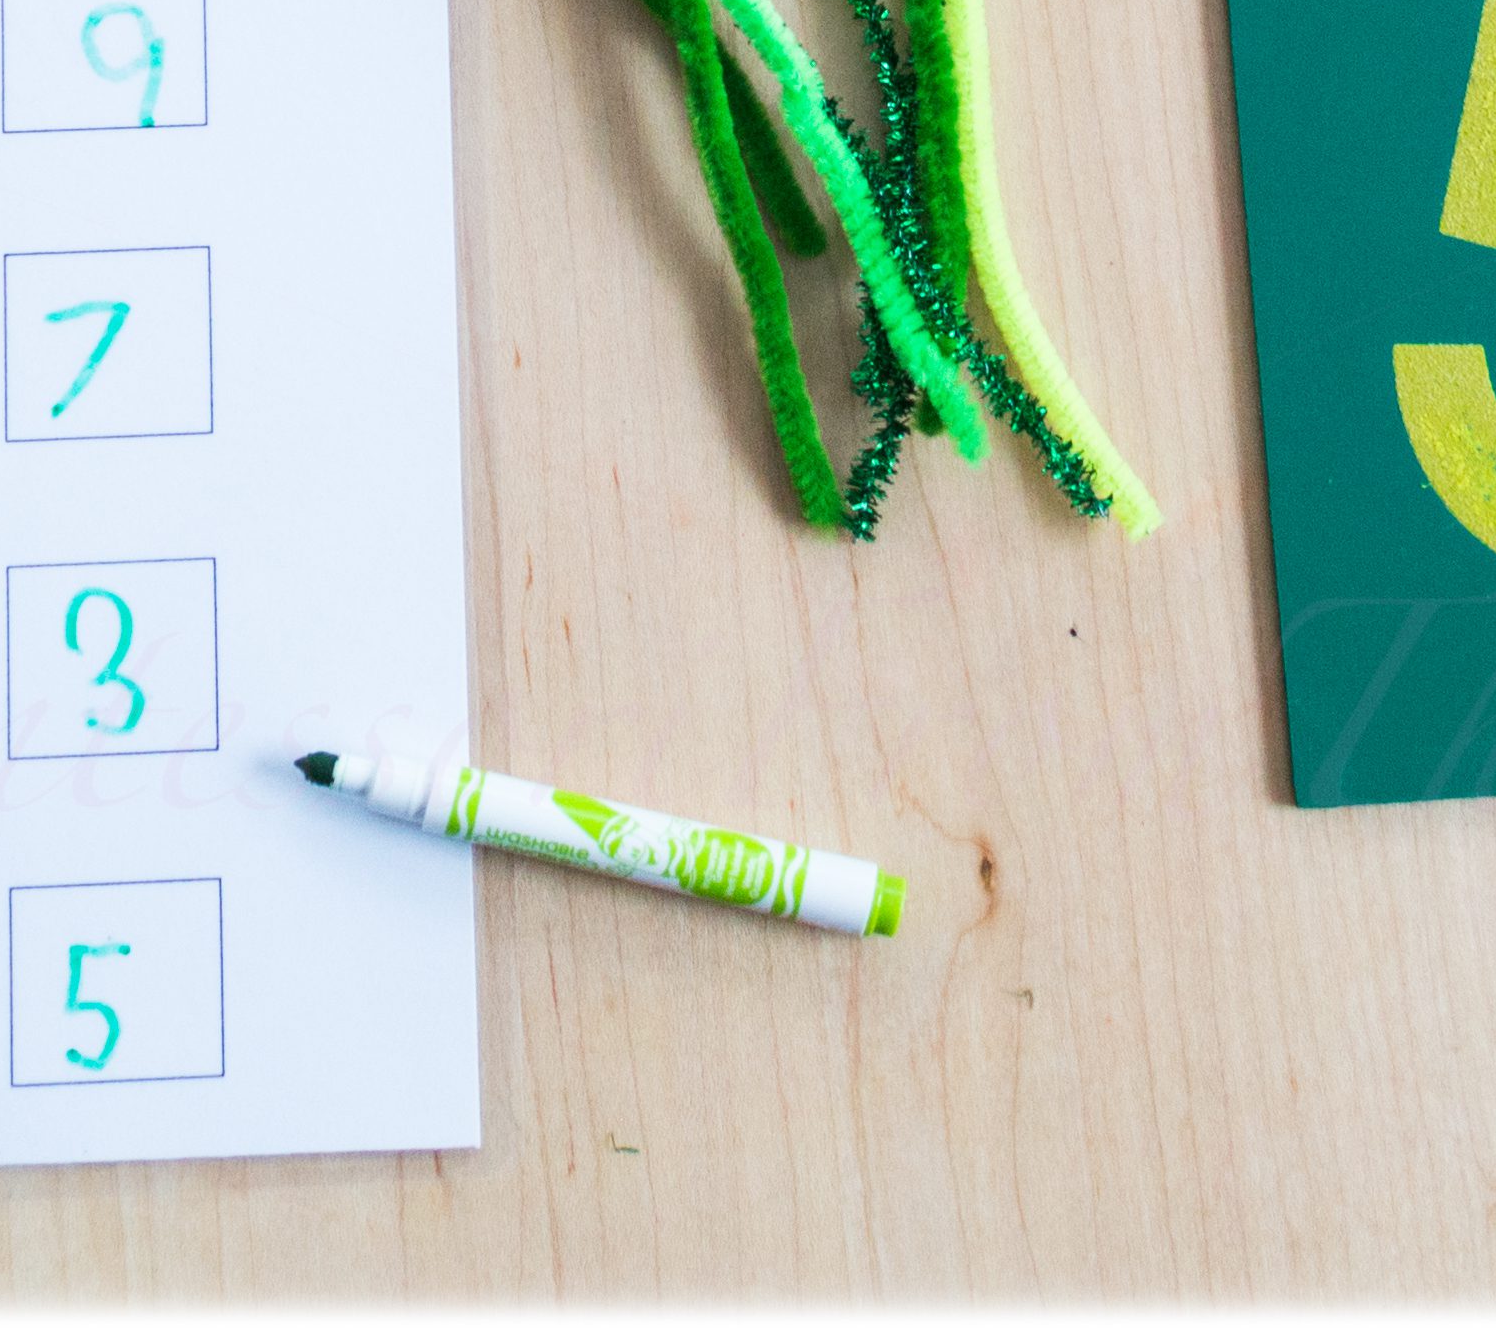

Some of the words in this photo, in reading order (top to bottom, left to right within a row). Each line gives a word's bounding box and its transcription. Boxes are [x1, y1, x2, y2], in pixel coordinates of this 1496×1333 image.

[80, 4, 166, 129] 9
[44, 300, 132, 420] 7
[62, 586, 147, 736] 3
[63, 942, 133, 1073] 5
